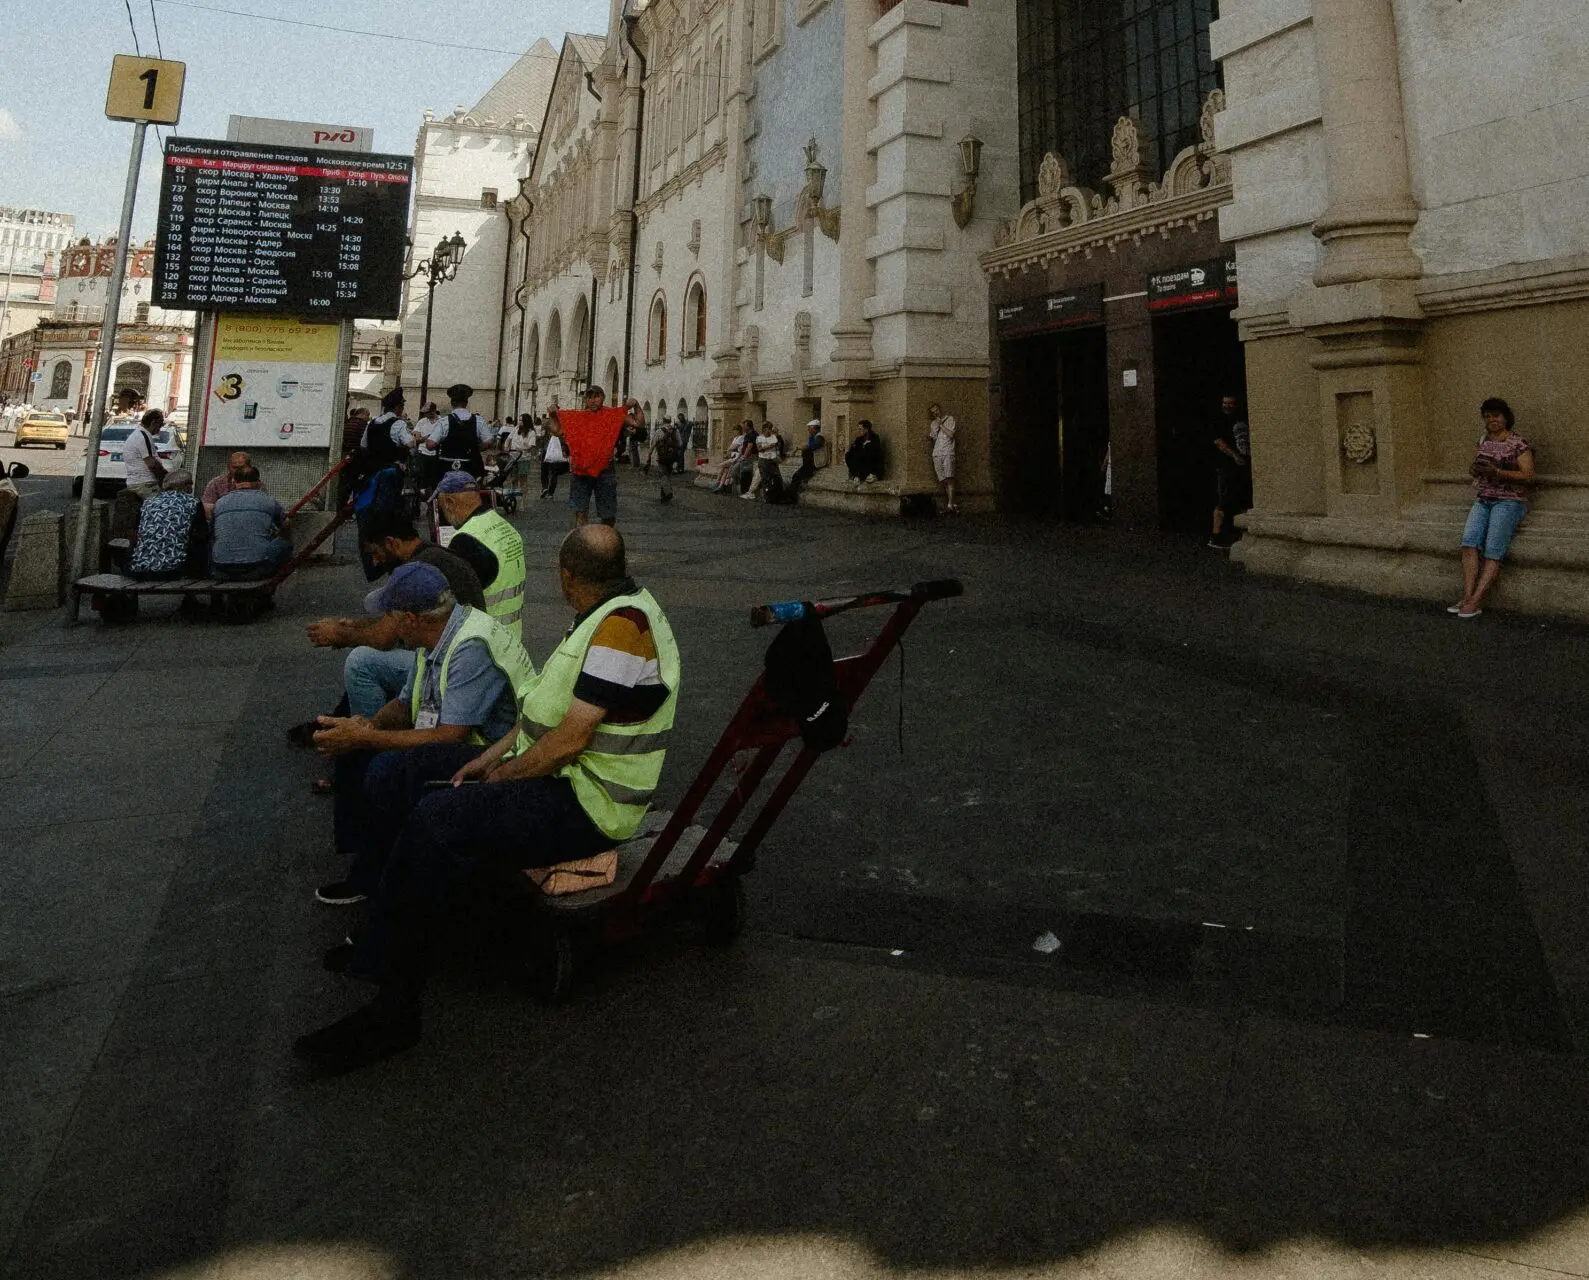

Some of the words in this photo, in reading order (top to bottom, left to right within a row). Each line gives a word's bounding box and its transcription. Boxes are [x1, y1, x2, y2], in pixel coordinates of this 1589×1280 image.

[139, 69, 158, 109] 1
[169, 144, 212, 154] Прибытие
[220, 150, 273, 160] отправление
[276, 154, 308, 163] поездов
[172, 156, 193, 165] Поезд
[223, 161, 255, 170] Маршрут
[316, 157, 361, 166] Московское
[386, 162, 407, 170] 12:51
[196, 177, 219, 186] фирм
[221, 179, 248, 187] Анапа
[256, 182, 287, 190] Москва
[320, 186, 340, 194] 13:30
[223, 170, 254, 178] Москва
[262, 173, 298, 182] Улан-Удэ
[346, 179, 367, 187] 13:10
[220, 189, 258, 198] Воронеж
[267, 192, 298, 200] Москва
[319, 196, 339, 204] 13:53
[196, 198, 216, 206] скор
[220, 199, 250, 208] Липецк
[259, 201, 290, 209] Москва
[318, 205, 338, 213] 14:10
[219, 208, 250, 216] Москва
[259, 211, 289, 220] Липецк
[343, 216, 364, 224] 14:20
[218, 218, 252, 226] Саранск
[260, 221, 292, 229] Москва
[191, 226, 215, 234] фирм
[222, 228, 280, 238] Новороссийск
[168, 234, 182, 242] 102
[190, 235, 214, 244] фирм
[216, 236, 248, 245] Москва
[256, 240, 282, 248] Адлер
[340, 244, 360, 252] 14:40
[191, 246, 211, 254] скор
[215, 247, 246, 255] Москва
[255, 249, 296, 258] Феодосия
[340, 253, 360, 261] 14:50
[191, 256, 211, 264] скор
[214, 256, 246, 265] Москва
[254, 258, 275, 266] Орск
[339, 262, 359, 270] 15:08
[213, 265, 240, 274] Анапа
[248, 267, 279, 276] Москва
[312, 270, 332, 278] 15:10
[189, 275, 209, 283] скор
[212, 275, 244, 284] Москва
[253, 277, 287, 286] Саранск
[337, 281, 357, 289] 15:16
[1156, 274, 1161, 284] К
[162, 292, 177, 300] 233
[187, 294, 207, 302] скор
[210, 295, 238, 303] Адлер
[245, 296, 276, 304] Москва
[212, 285, 244, 293] Москва
[252, 287, 287, 295] Грозный
[336, 290, 356, 298] 15:34
[236, 325, 261, 333] (800)
